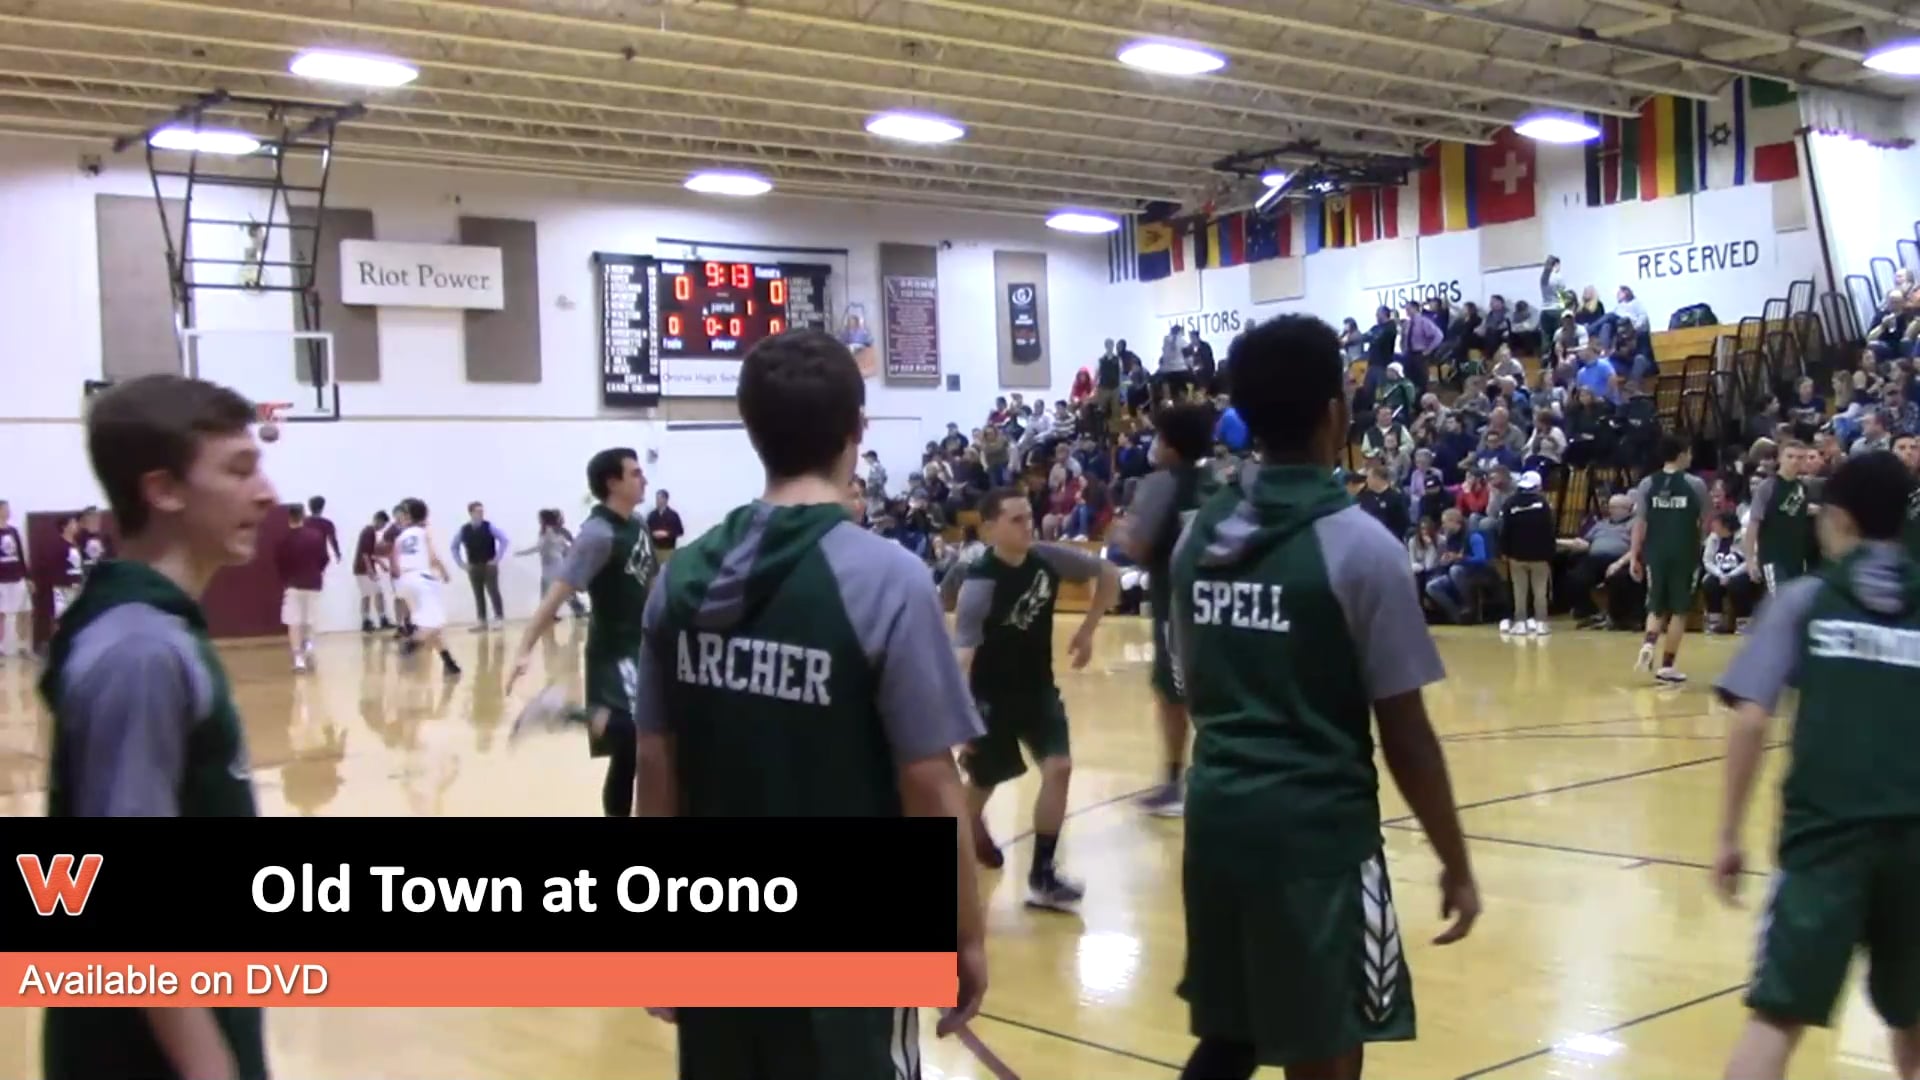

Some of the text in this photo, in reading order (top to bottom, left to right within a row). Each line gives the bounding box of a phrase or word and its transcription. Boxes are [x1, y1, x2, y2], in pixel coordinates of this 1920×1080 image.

[358, 259, 491, 291] Riot Power
[705, 262, 749, 288] 9:13
[1637, 239, 1760, 281] RESERVED
[675, 275, 690, 301] 0
[769, 279, 784, 305] 0
[1377, 280, 1462, 310] VISITORS
[668, 315, 680, 336] 0
[1192, 581, 1290, 632] SPELL
[677, 632, 832, 706] ARCHER
